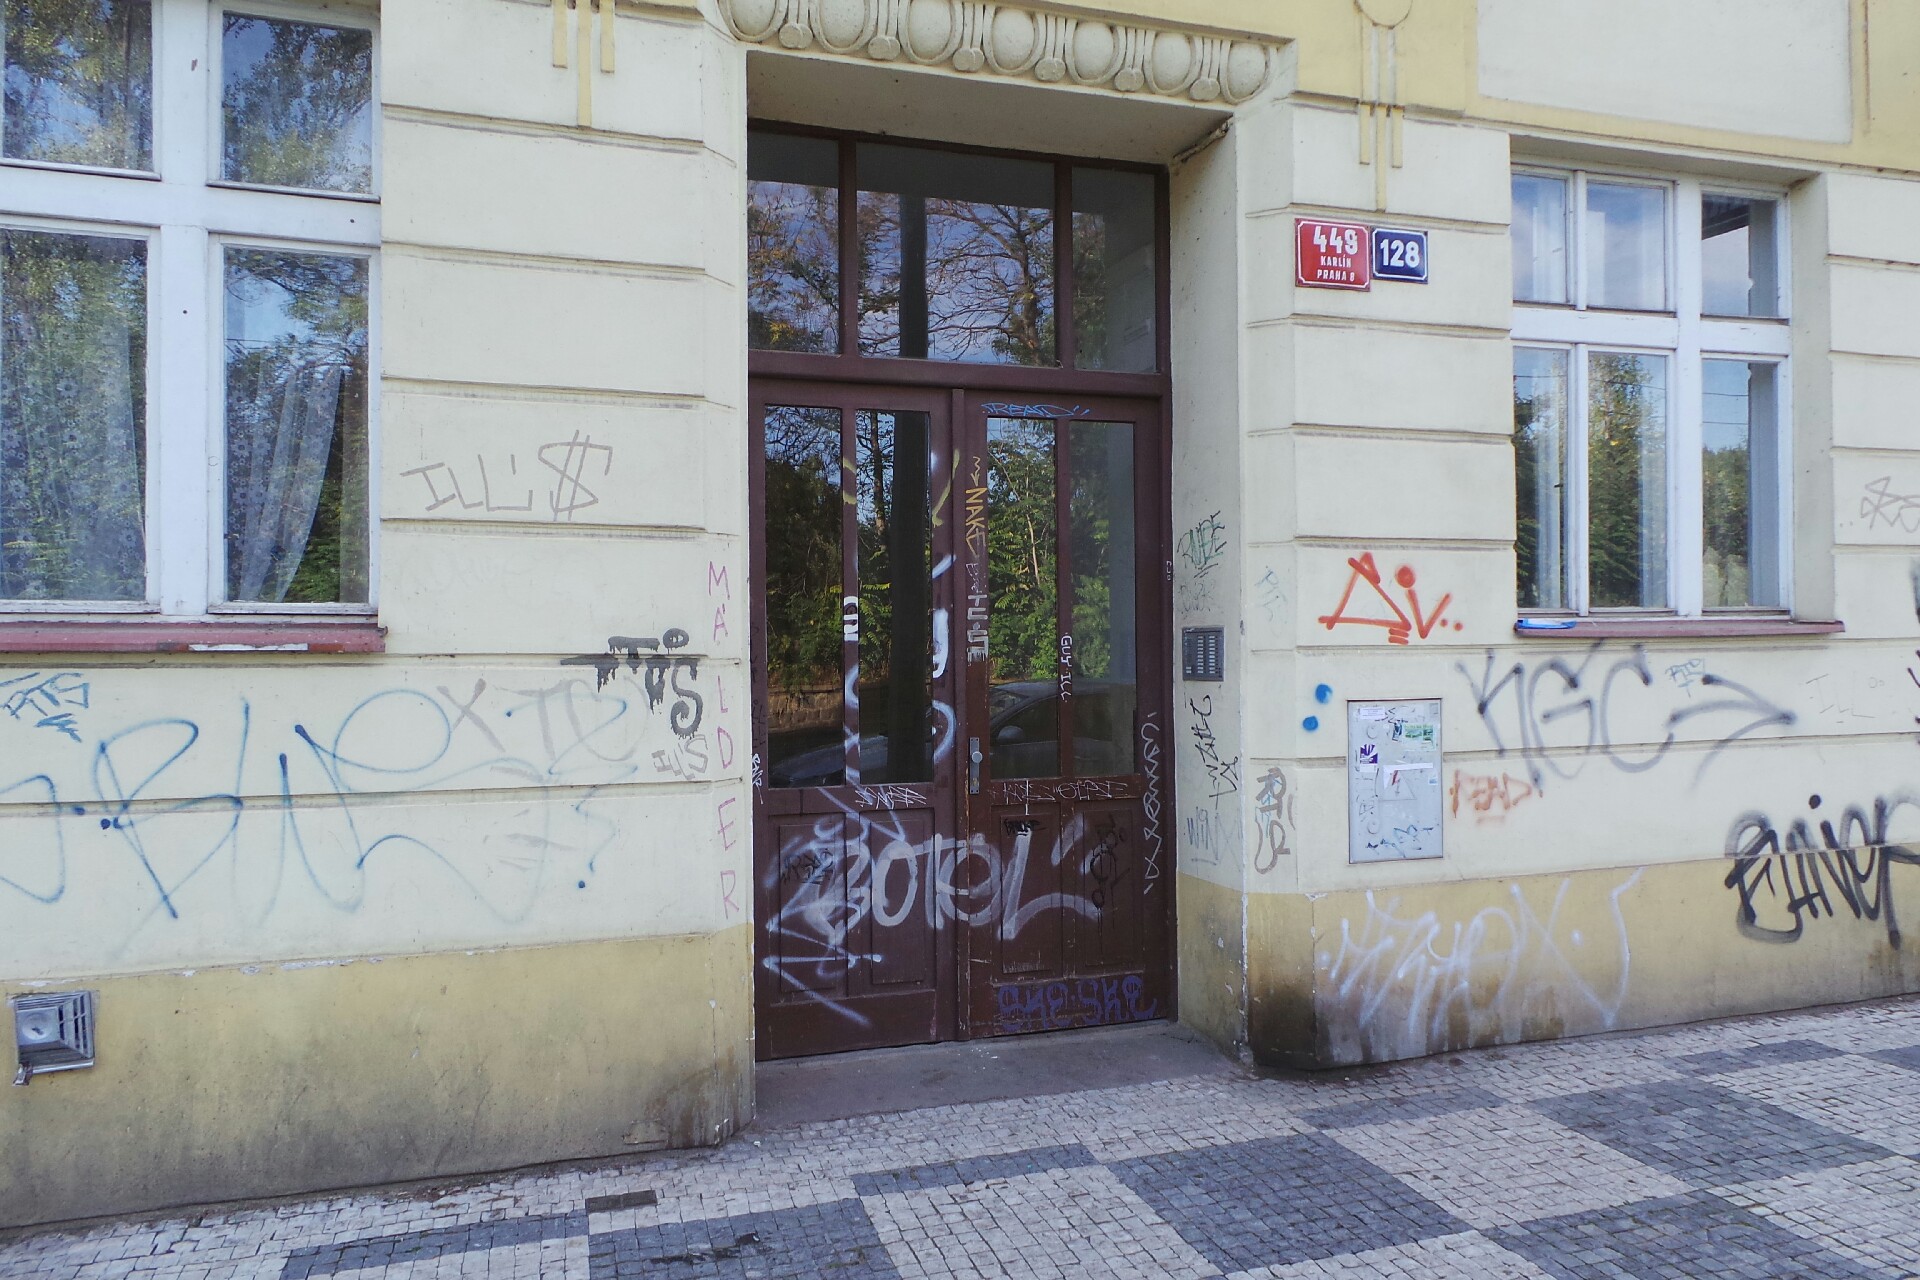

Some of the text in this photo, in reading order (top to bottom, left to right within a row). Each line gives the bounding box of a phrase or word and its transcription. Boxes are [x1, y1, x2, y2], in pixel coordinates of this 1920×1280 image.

[1313, 225, 1358, 255] 449
[1320, 254, 1352, 268] KARLÍN
[1380, 239, 1420, 268] 128
[1316, 269, 1355, 282] PRAHA 8
